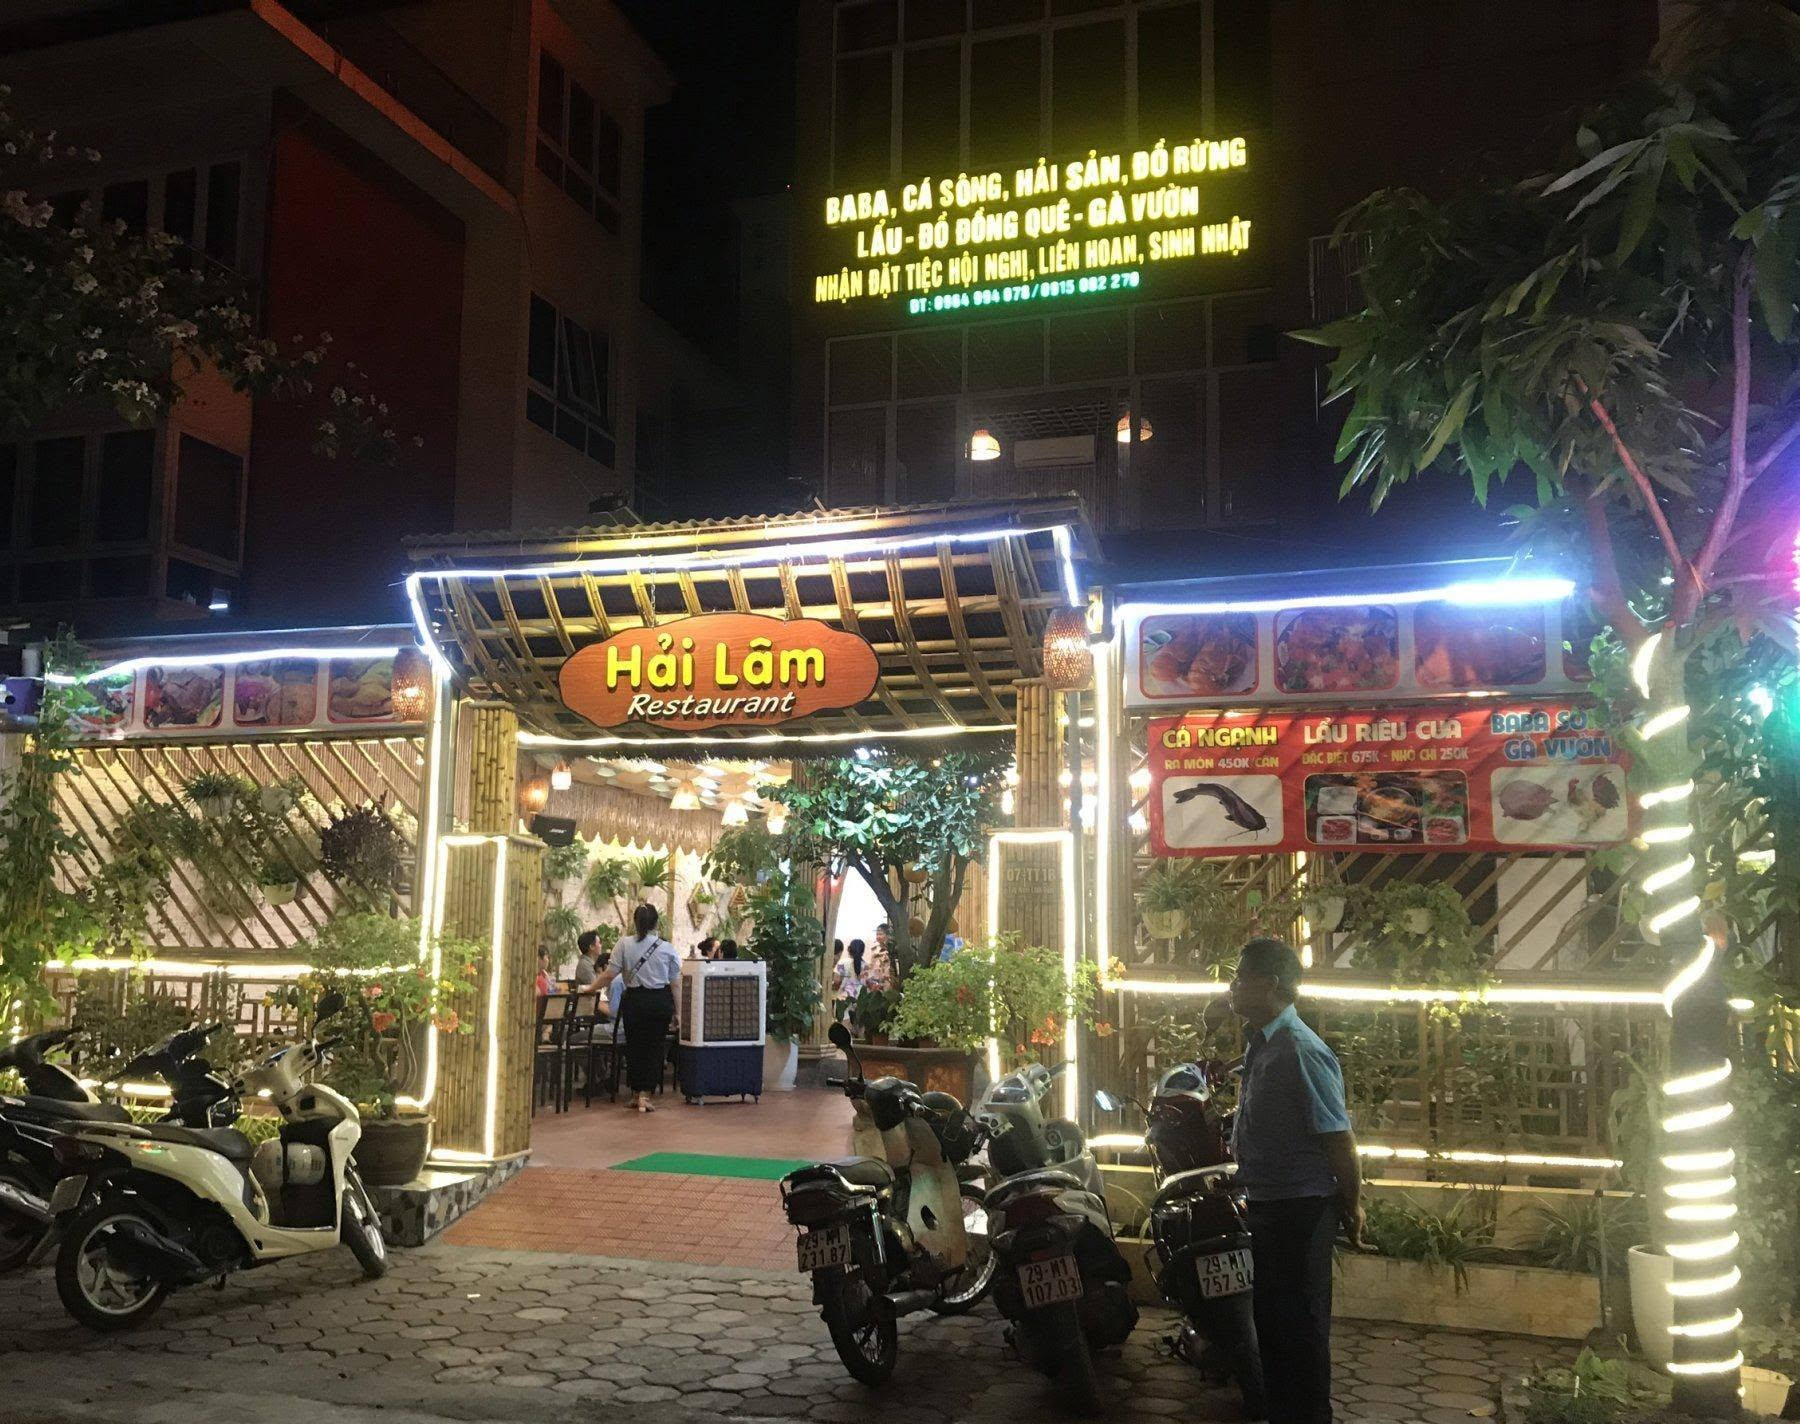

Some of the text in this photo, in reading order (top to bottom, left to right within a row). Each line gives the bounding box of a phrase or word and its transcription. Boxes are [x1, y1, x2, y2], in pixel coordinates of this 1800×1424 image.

[903, 177, 932, 212] CÁ
[939, 172, 1009, 207] SÔNG,
[1015, 157, 1058, 198] HẢI
[1173, 137, 1247, 175] RỪNG
[1131, 183, 1199, 222] VƯỜN
[815, 266, 863, 303] NHẬN
[868, 262, 901, 298] ĐẶT
[905, 256, 943, 293] TIỆC
[948, 250, 978, 288] HỘI
[1039, 238, 1080, 275] LIÊN
[1149, 227, 1195, 261] SINH
[1201, 215, 1251, 256] NHẬT
[606, 632, 825, 689] Hải Lâm
[627, 692, 796, 717] Restaurant
[1303, 717, 1463, 745] LẨU RIÊU CUA
[1490, 711, 1551, 735] BABA
[1162, 725, 1279, 751] CÁ NGẠNH
[1503, 731, 1612, 761] GÀ VƯỜN
[1351, 750, 1380, 764] 675K
[1440, 747, 1470, 761] 250K
